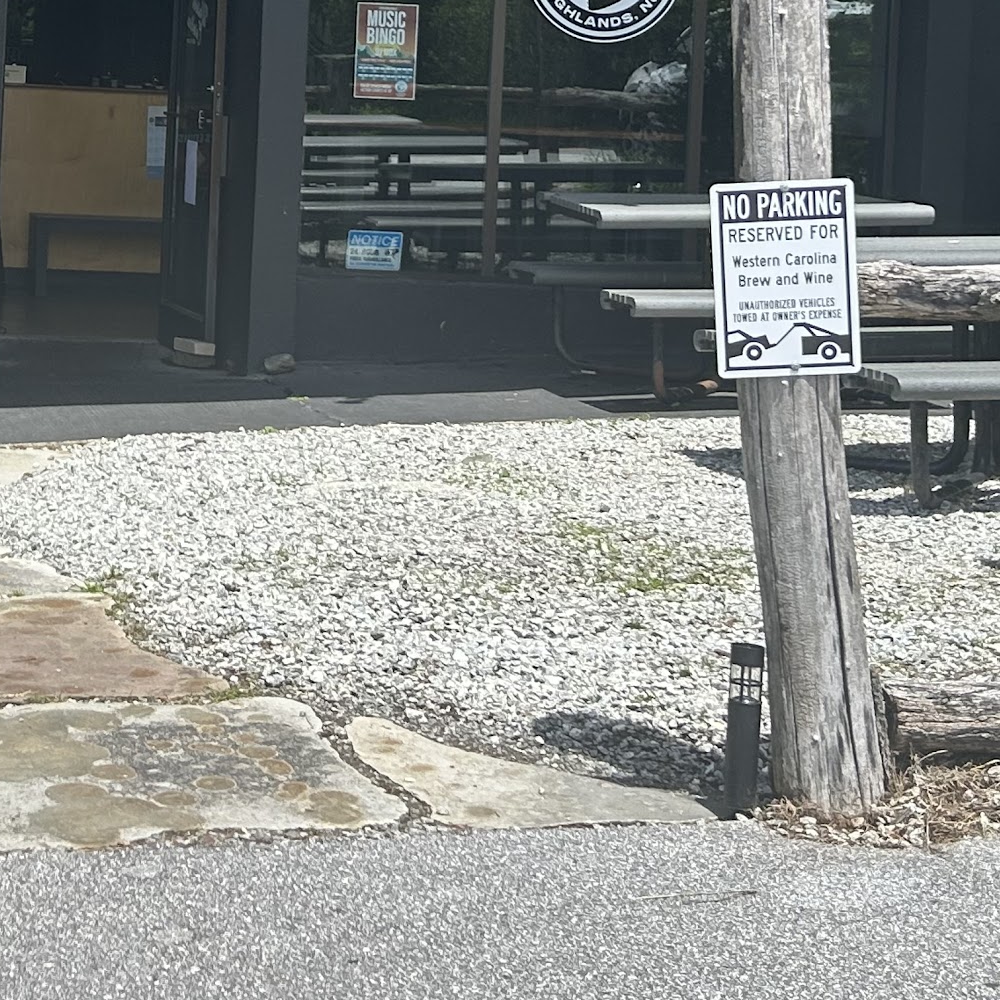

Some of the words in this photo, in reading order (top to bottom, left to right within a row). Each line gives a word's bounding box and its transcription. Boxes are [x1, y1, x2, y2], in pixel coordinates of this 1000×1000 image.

[367, 9, 407, 28] MUSIC
[366, 27, 405, 46] BINGO
[722, 193, 750, 220] NO
[756, 190, 842, 219] PARKING
[350, 234, 400, 247] NOTICE
[728, 226, 803, 243] RESERVED
[810, 224, 839, 240] FOR
[732, 255, 780, 268] Western
[785, 252, 837, 266] Carolina
[738, 274, 771, 287] Brew
[776, 273, 799, 286] and
[804, 271, 833, 284] Wine
[738, 299, 796, 311] UNAUTHORIZED
[799, 297, 835, 308] VEHICLES
[733, 313, 757, 323] TOWED
[760, 312, 769, 321] AT
[772, 310, 806, 321] OWNER'S
[808, 309, 842, 320] EXPENSE
